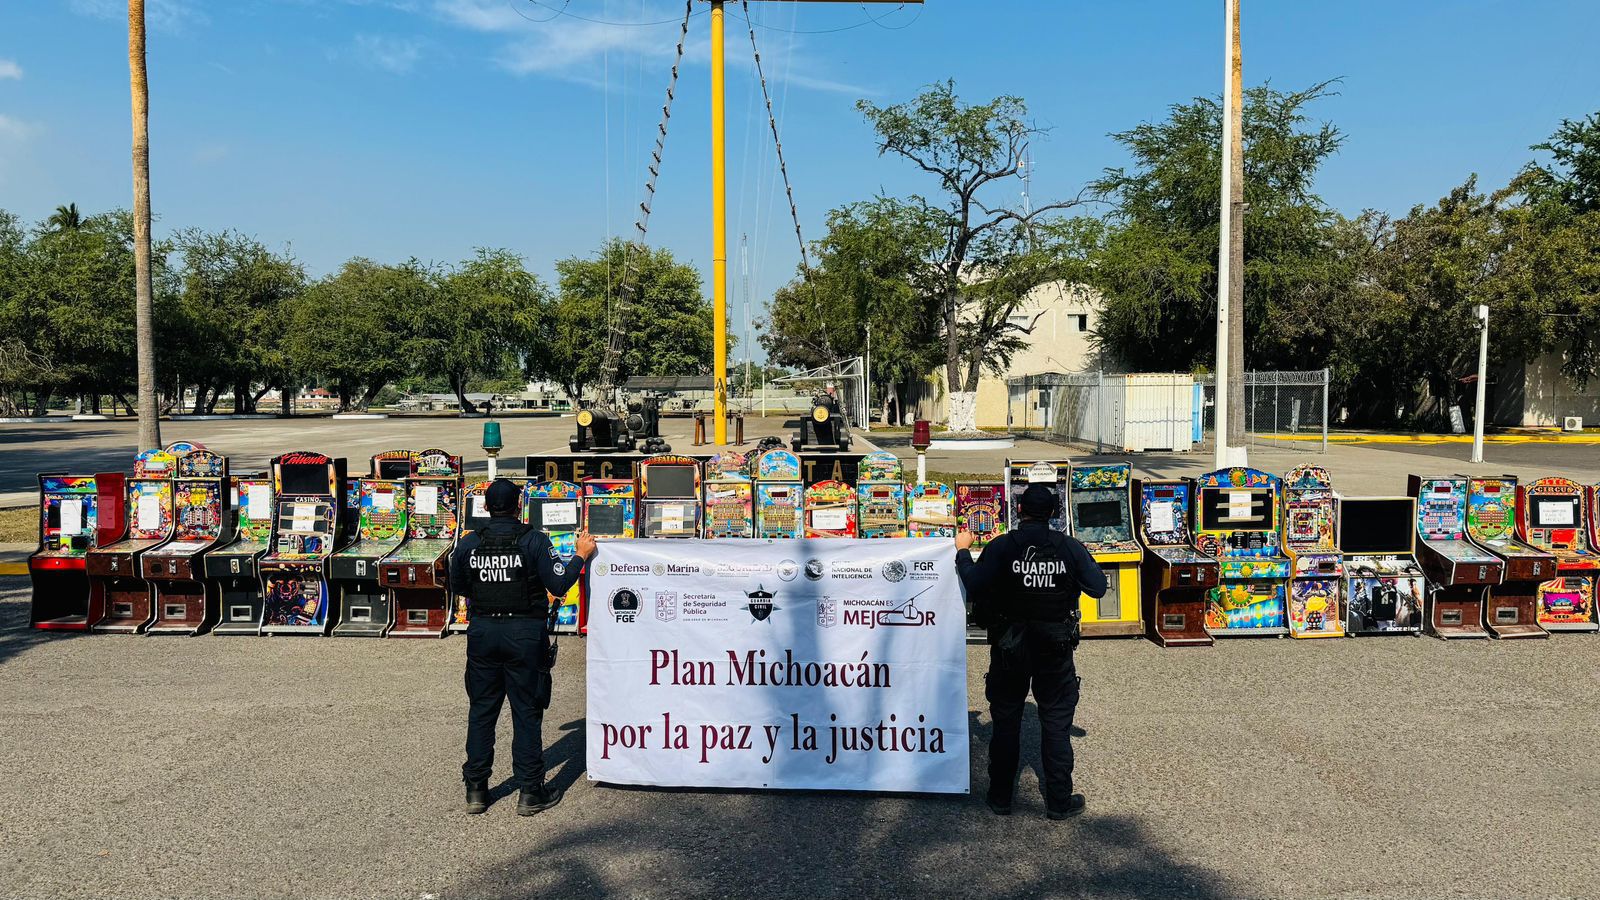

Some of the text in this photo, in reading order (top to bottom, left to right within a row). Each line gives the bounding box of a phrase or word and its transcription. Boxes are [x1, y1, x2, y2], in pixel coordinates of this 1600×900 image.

[280, 453, 328, 465] Caliente
[470, 554, 523, 570] GUARDIA
[913, 561, 934, 571] FGR
[1012, 560, 1067, 574] GUARDIA
[611, 563, 650, 573] Defensa
[667, 563, 699, 573] Marina
[479, 569, 511, 582] CIVIL
[1023, 573, 1056, 588] CIVIL
[683, 592, 716, 600] Secretaría
[693, 600, 727, 609] Seguridad
[843, 598, 885, 606] MICHOACÁN
[683, 607, 707, 615] Pública
[616, 614, 635, 623] FGE
[648, 649, 892, 688] Plan Michoacán
[600, 712, 946, 764] por la paz y la justicia
